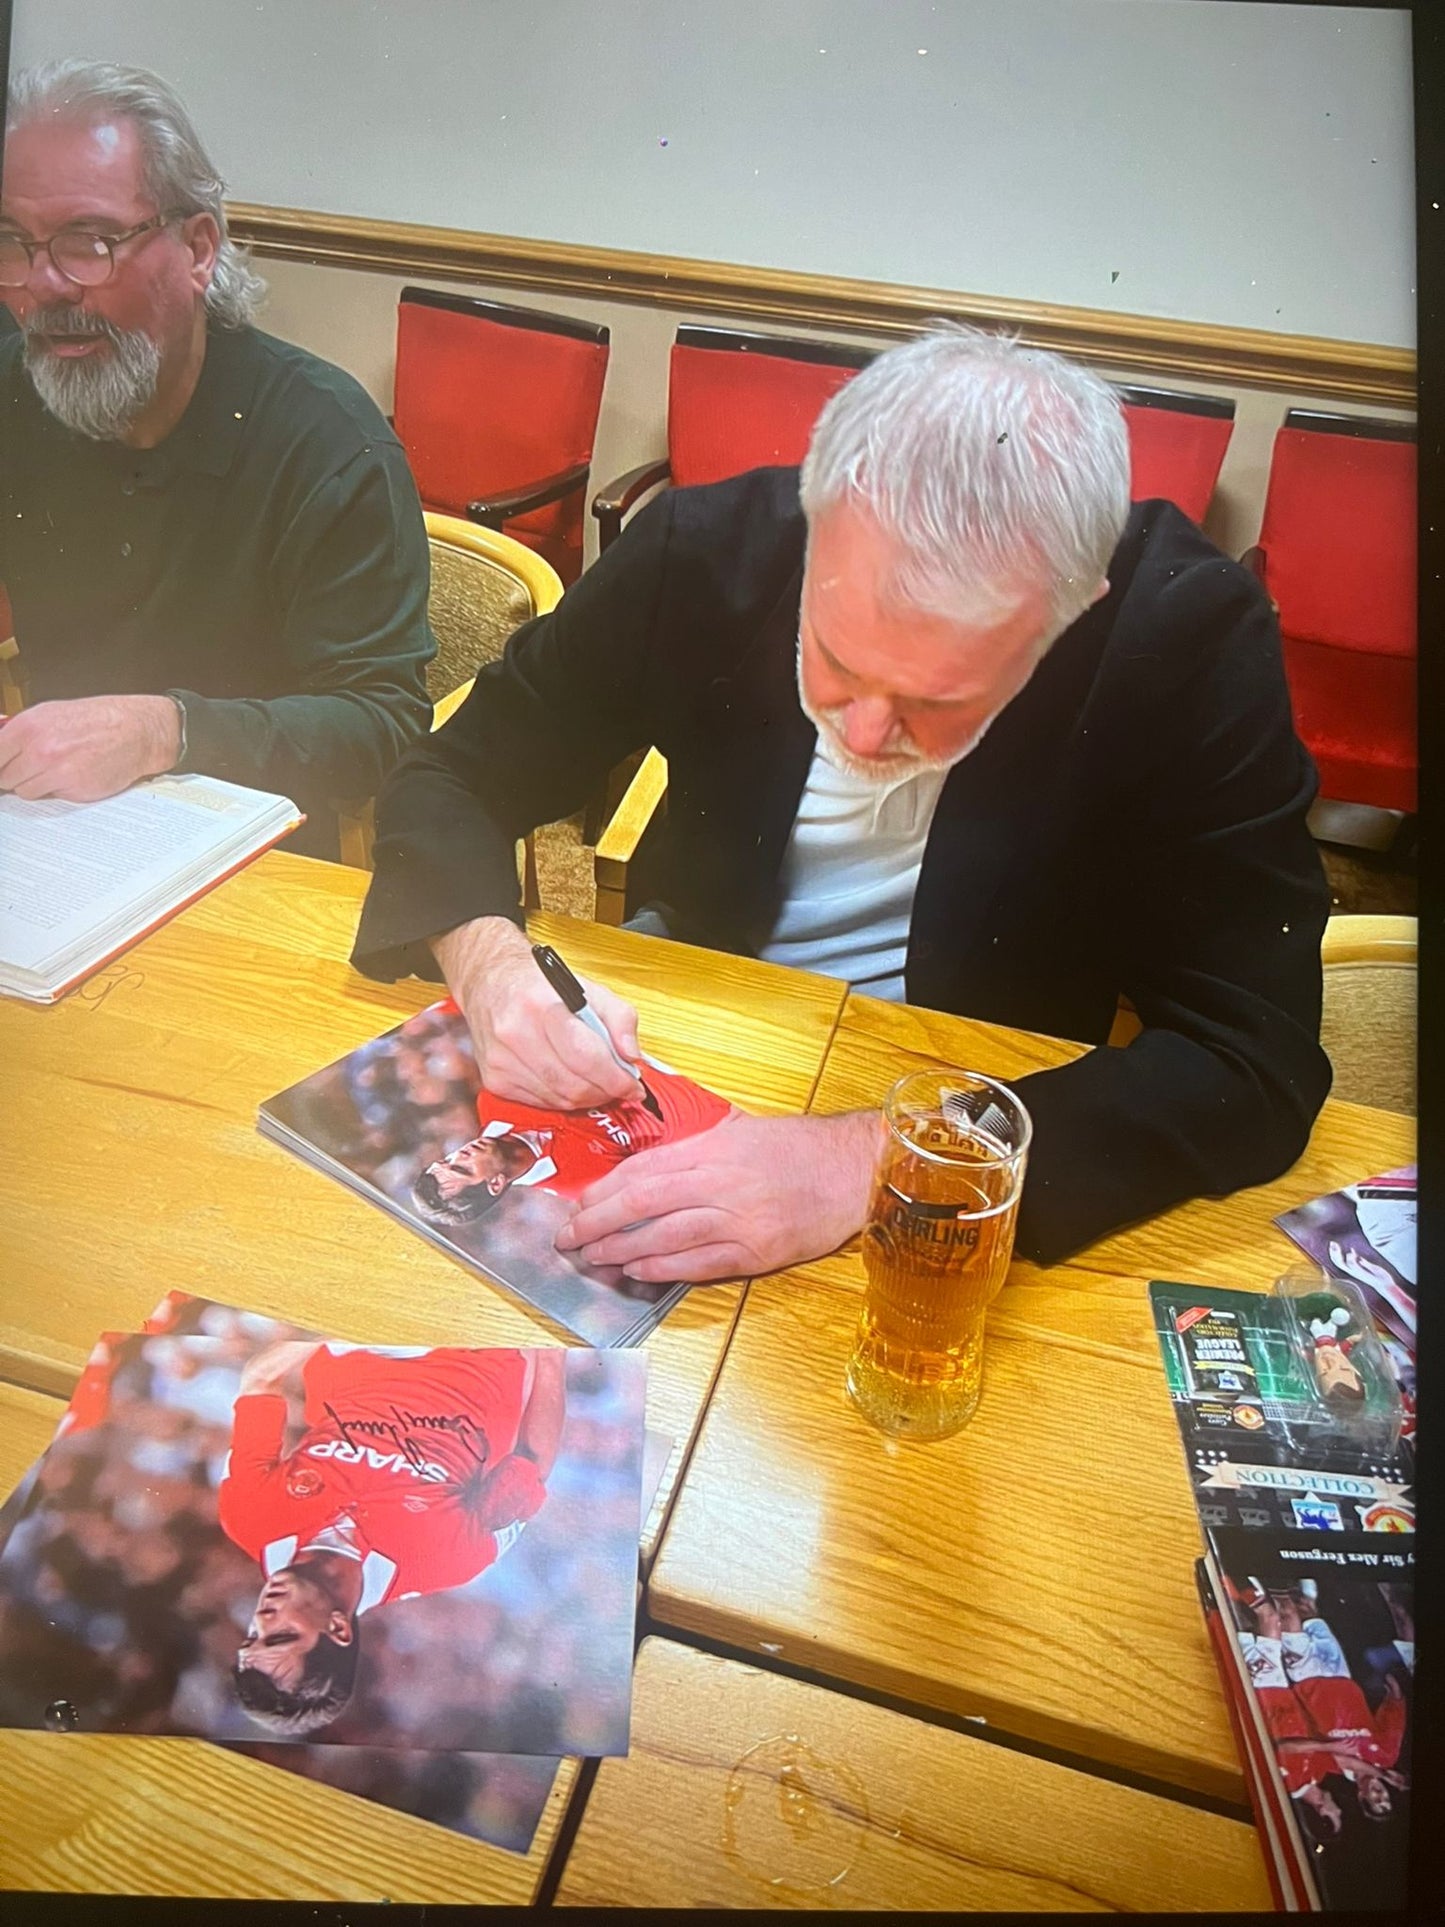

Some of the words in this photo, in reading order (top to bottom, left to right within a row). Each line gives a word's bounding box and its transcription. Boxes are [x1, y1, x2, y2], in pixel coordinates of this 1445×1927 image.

[586, 1108, 632, 1147] SHA
[1194, 1338, 1242, 1350] LEAGUE
[1194, 1349, 1246, 1361] PREMIER
[308, 1440, 449, 1483] SHARP
[1235, 1469, 1376, 1496] COLLECTION
[1279, 1549, 1347, 1566] Ferguson
[1348, 1554, 1379, 1567] Alex
[1382, 1554, 1406, 1567] Sir
